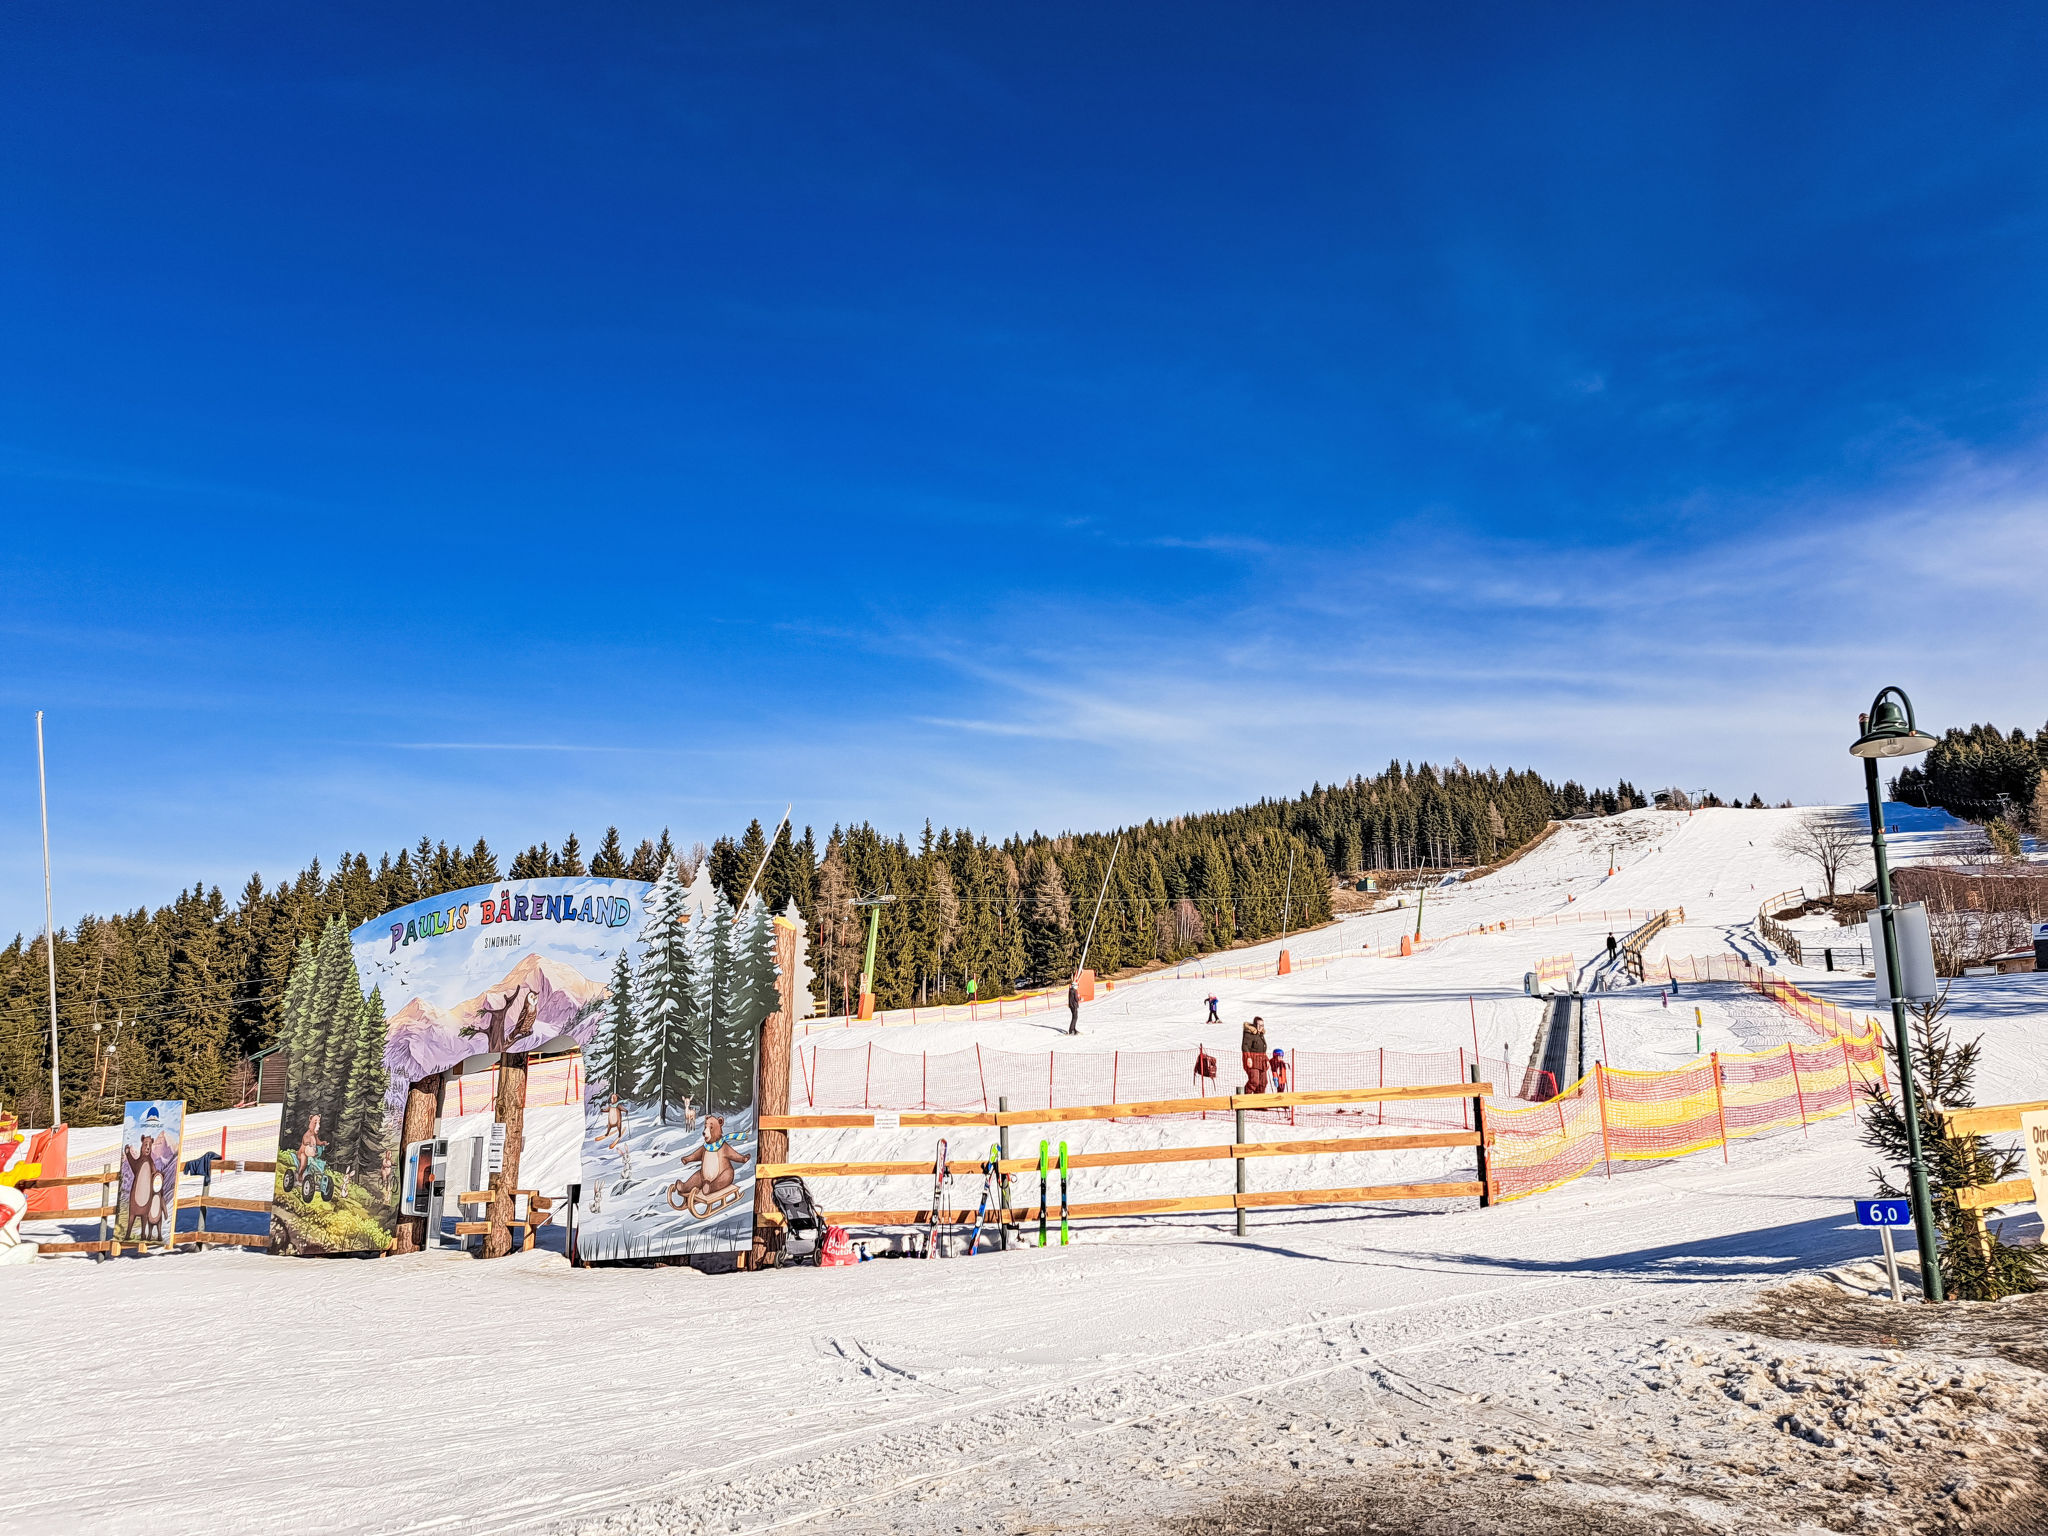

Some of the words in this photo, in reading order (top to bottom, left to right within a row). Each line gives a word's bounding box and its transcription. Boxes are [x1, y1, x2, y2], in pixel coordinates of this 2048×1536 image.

[390, 901, 470, 954] PAULIS
[480, 889, 631, 928] BÄRENLAND
[484, 934, 521, 949] SIMONHÖHE
[1869, 1203, 1898, 1224] 6,0
